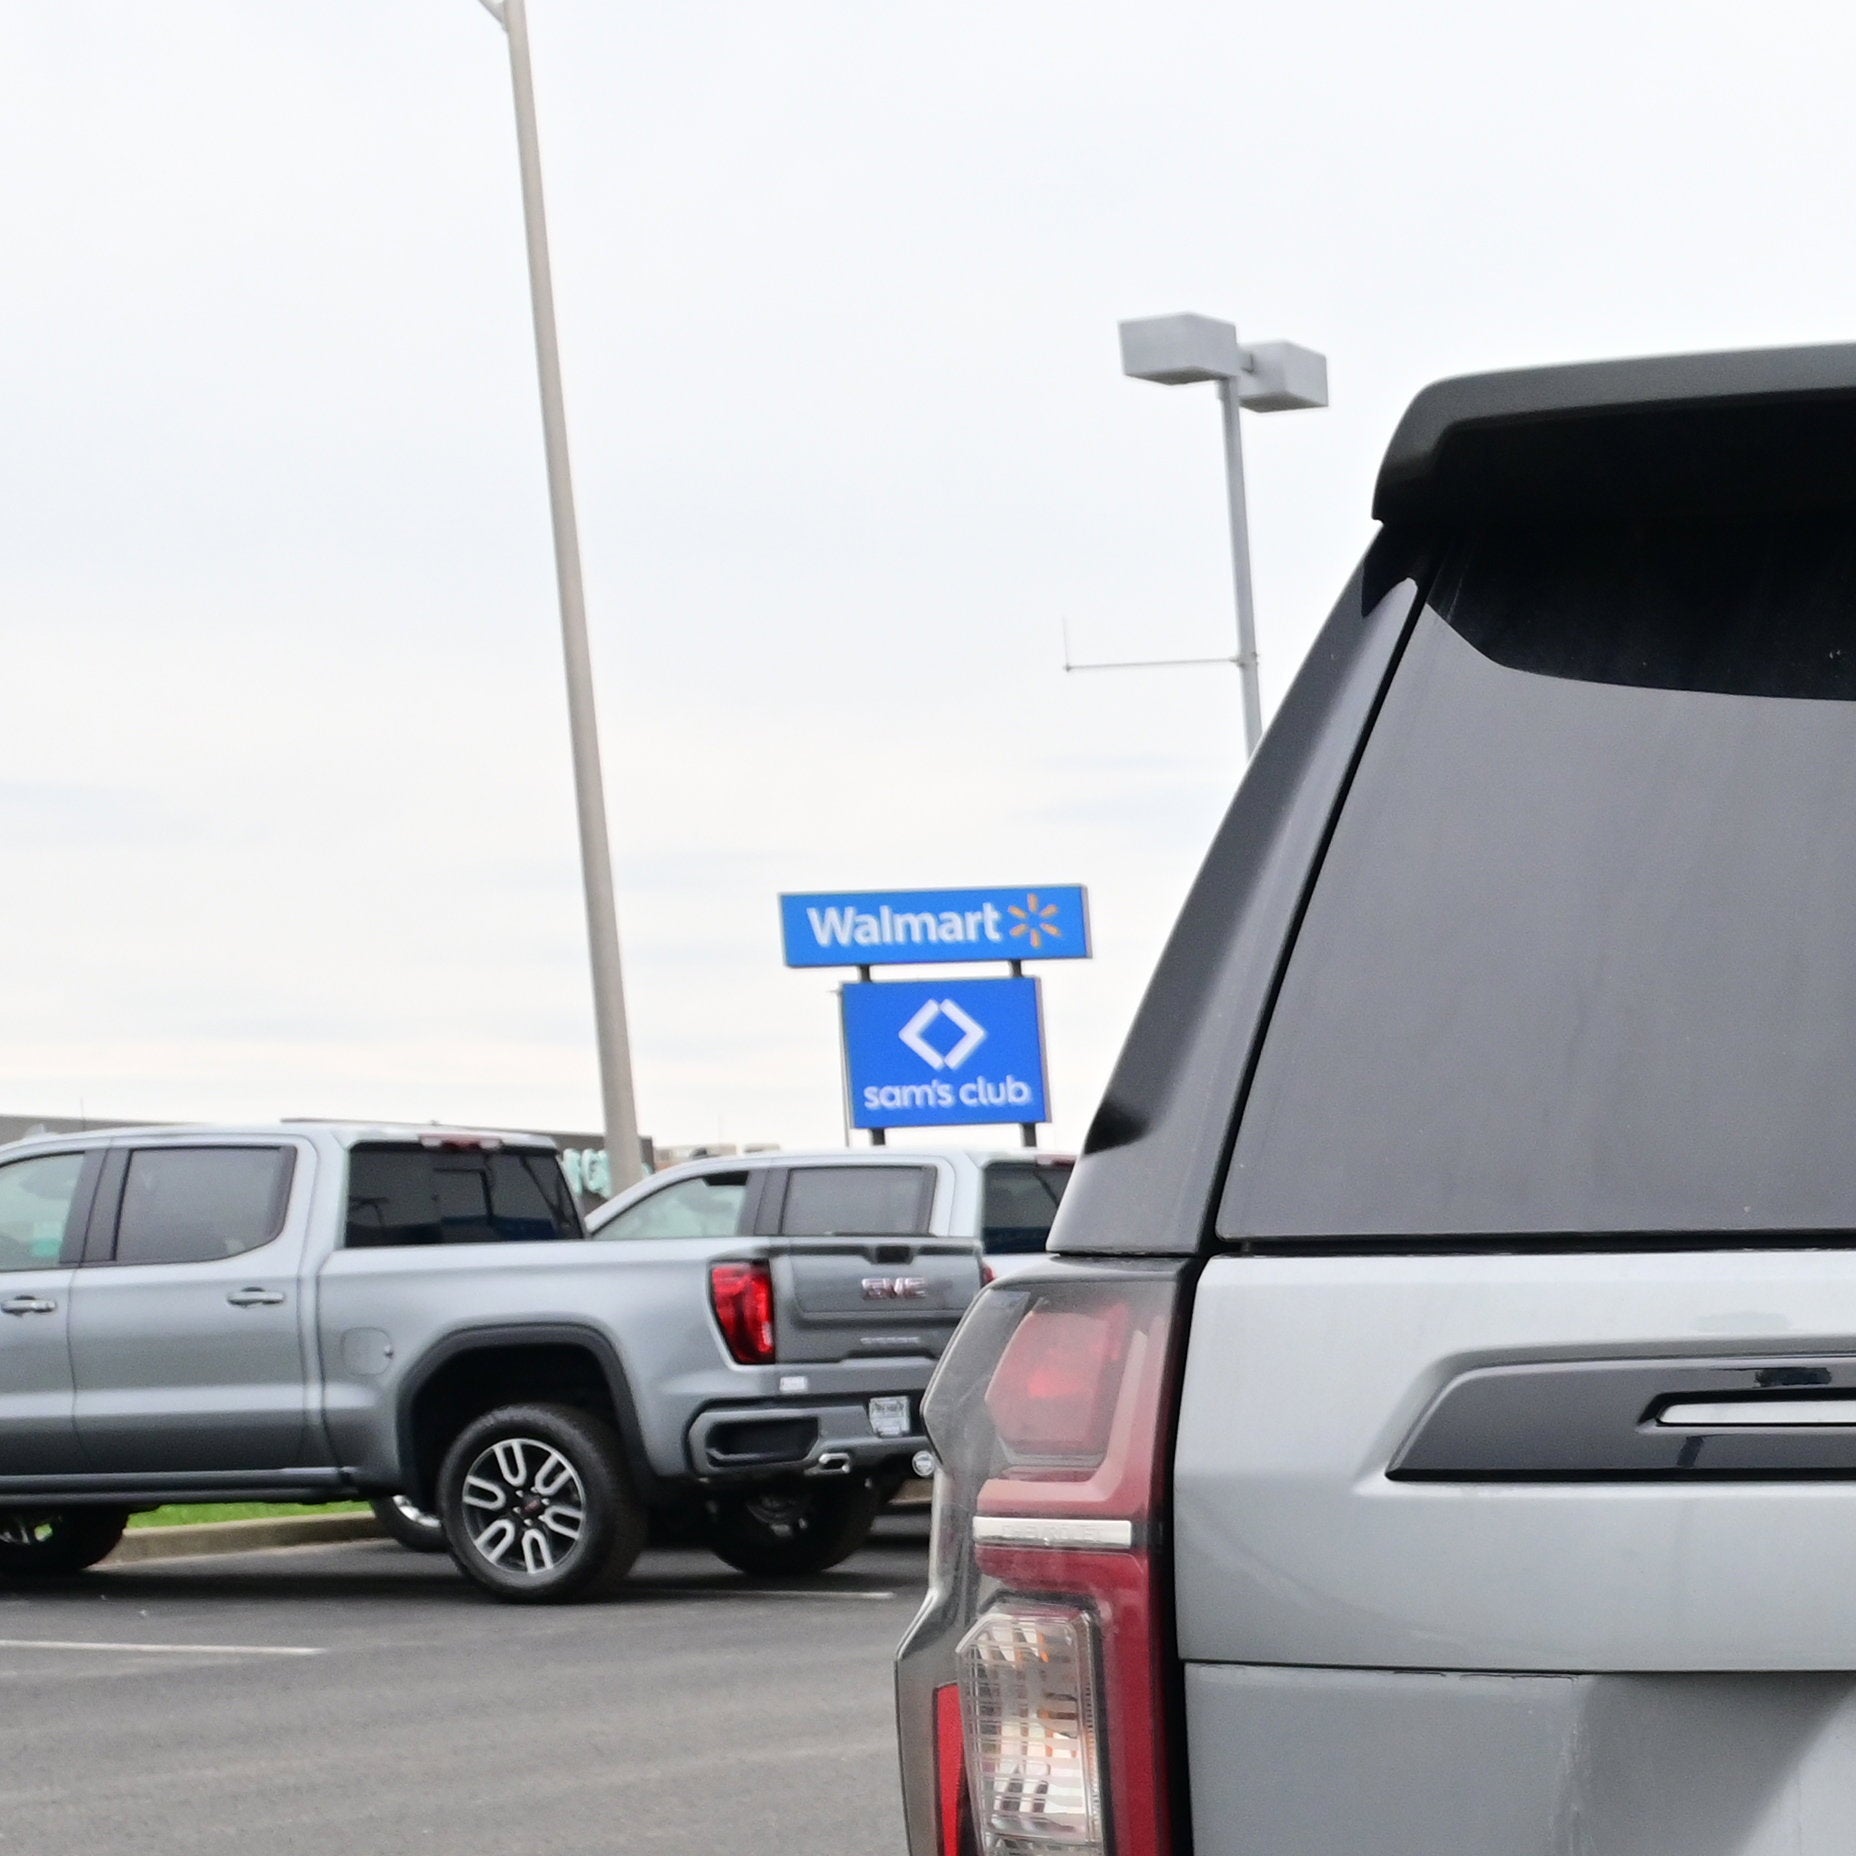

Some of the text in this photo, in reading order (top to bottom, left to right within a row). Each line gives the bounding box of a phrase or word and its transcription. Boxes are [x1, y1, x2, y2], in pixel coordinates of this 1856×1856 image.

[806, 902, 1003, 946] Walmart
[864, 1075, 1031, 1109] sam's club
